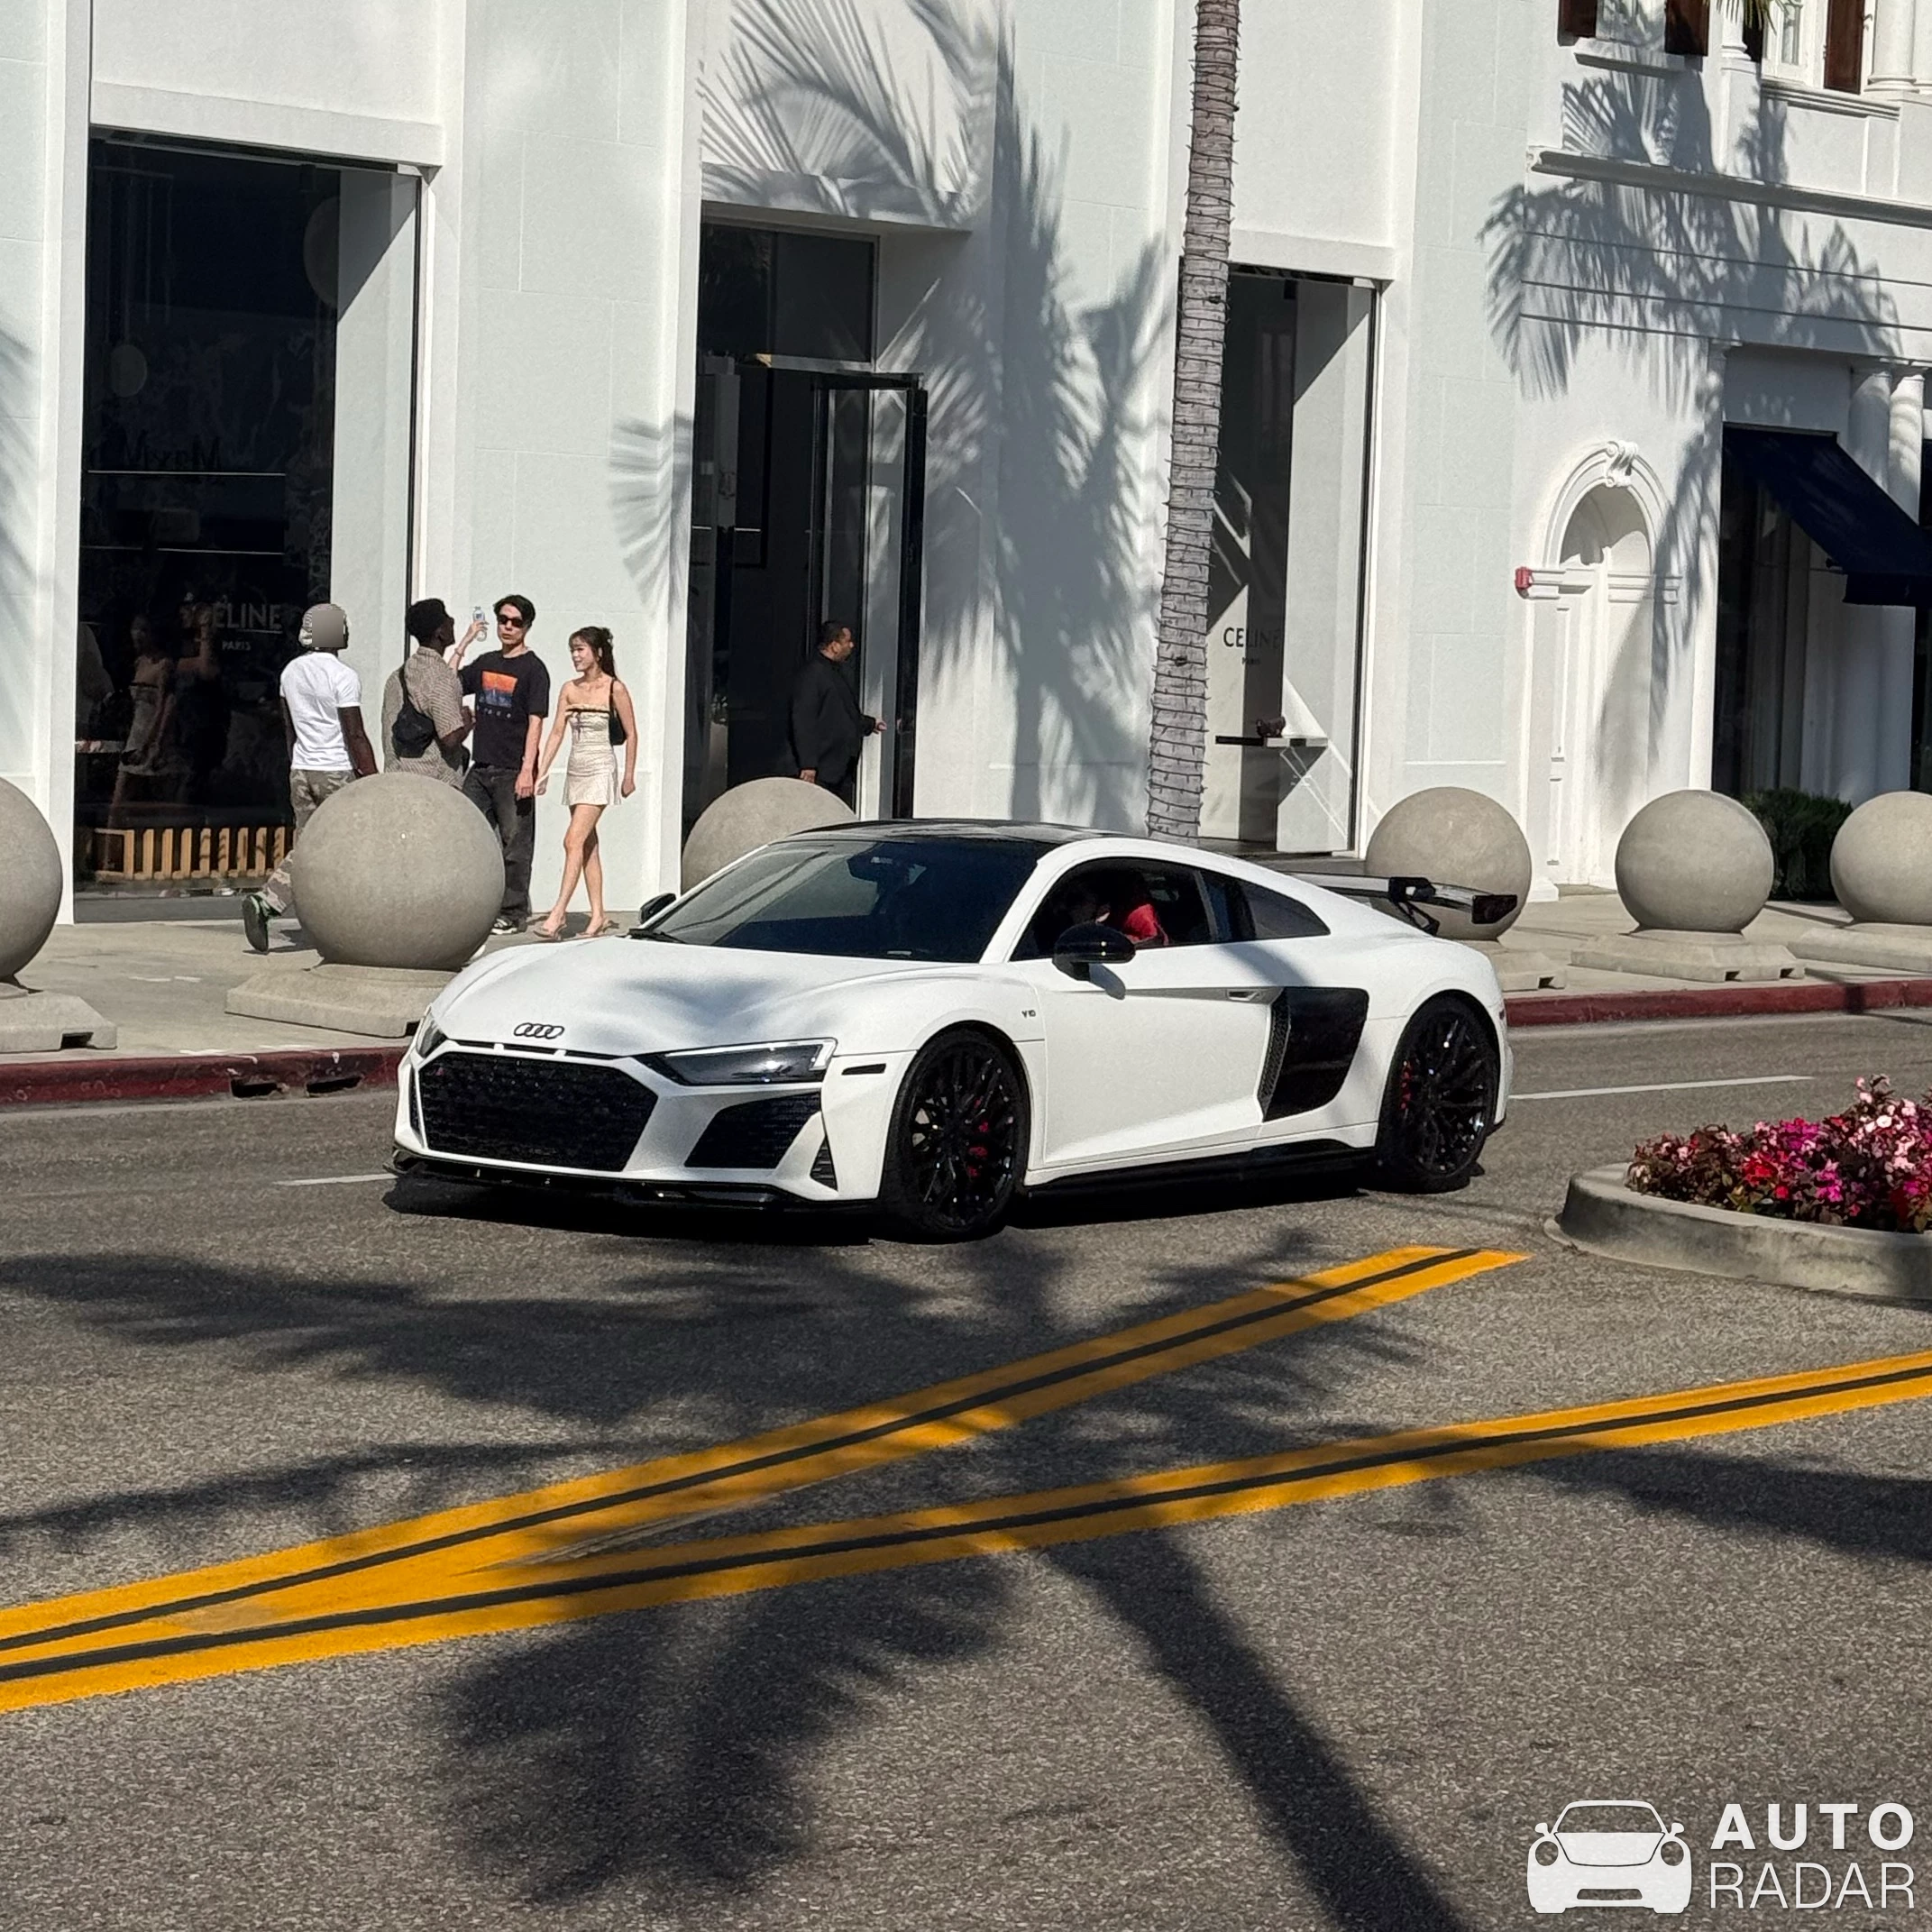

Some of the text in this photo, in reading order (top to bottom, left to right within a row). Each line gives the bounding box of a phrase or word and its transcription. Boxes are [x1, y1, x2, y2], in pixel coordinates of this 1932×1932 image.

[1222, 627, 1281, 649] CELINE
[221, 639, 252, 652] PARIS
[1021, 1009, 1037, 1019] V10
